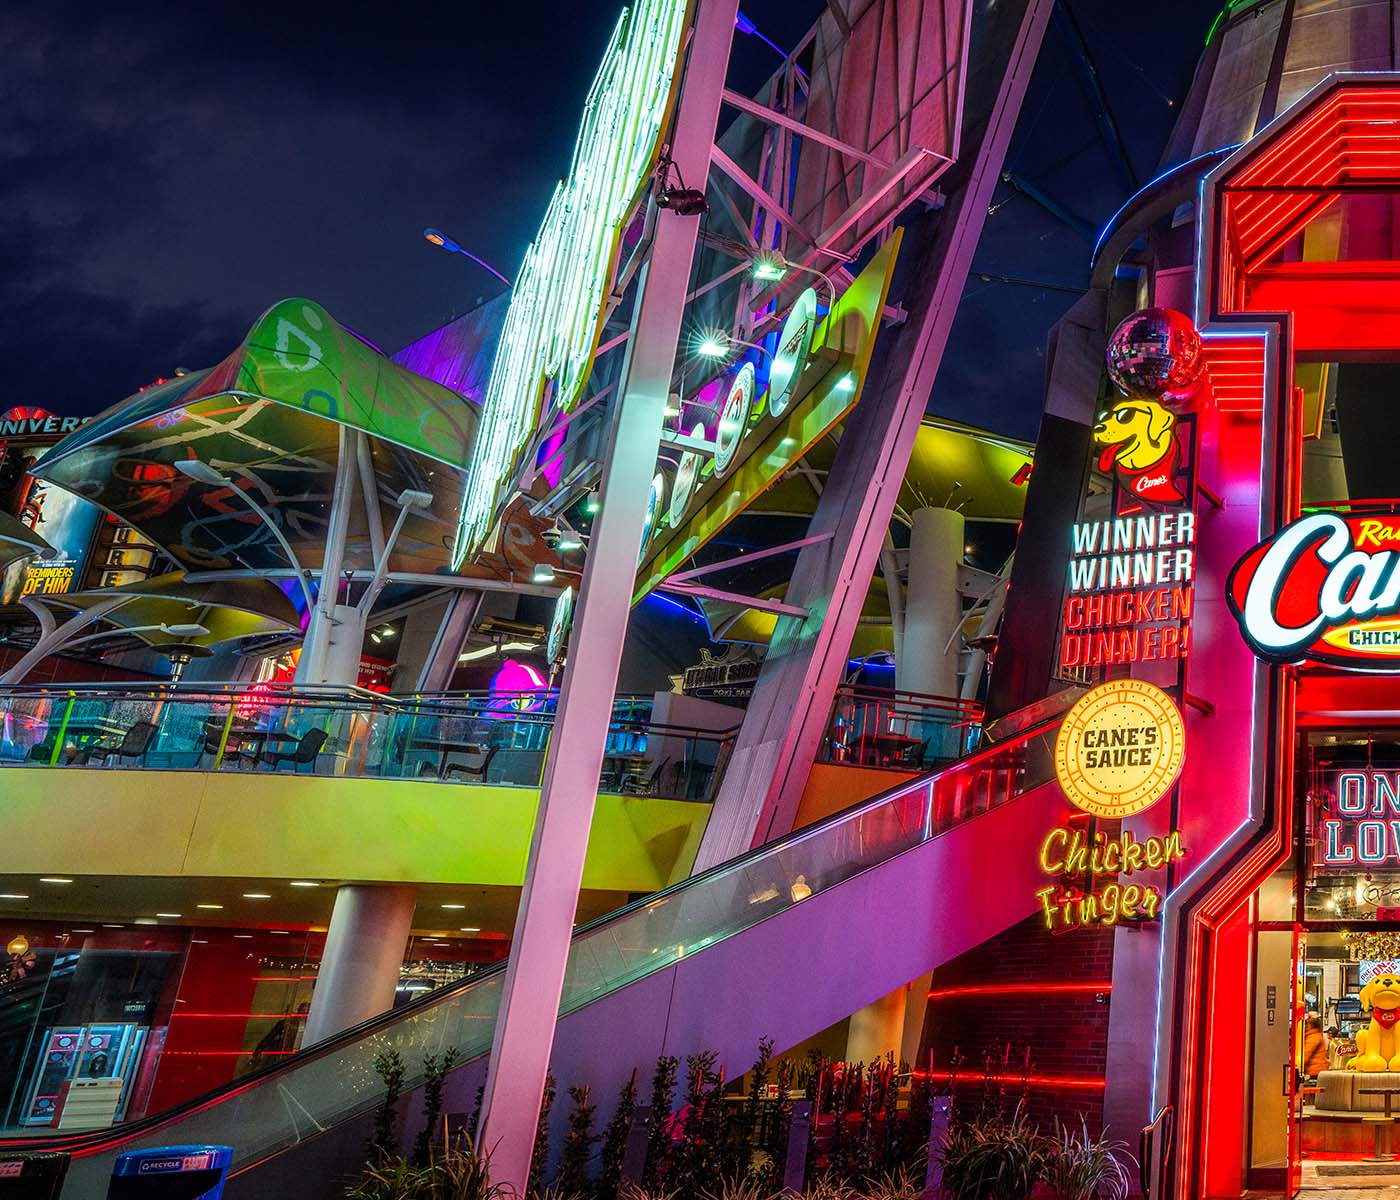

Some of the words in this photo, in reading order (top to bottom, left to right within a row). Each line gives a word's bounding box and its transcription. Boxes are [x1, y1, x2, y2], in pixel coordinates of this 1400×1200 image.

[0, 417, 93, 435] NIVER
[1135, 475, 1167, 492] Cane's
[1073, 512, 1195, 554] WINNER
[27, 567, 75, 578] REMINDERS
[1070, 549, 1193, 591] WINNER
[22, 578, 44, 594] OF
[42, 577, 72, 594] HIM
[1065, 587, 1193, 629] CHICKEN
[1062, 625, 1190, 666] DINNER!
[1084, 726, 1157, 748] CANE'S
[1085, 748, 1153, 769] SAUCE
[1040, 827, 1185, 873] Chicken
[1037, 884, 1160, 930] Finger
[150, 1161, 180, 1169] RECYCLE
